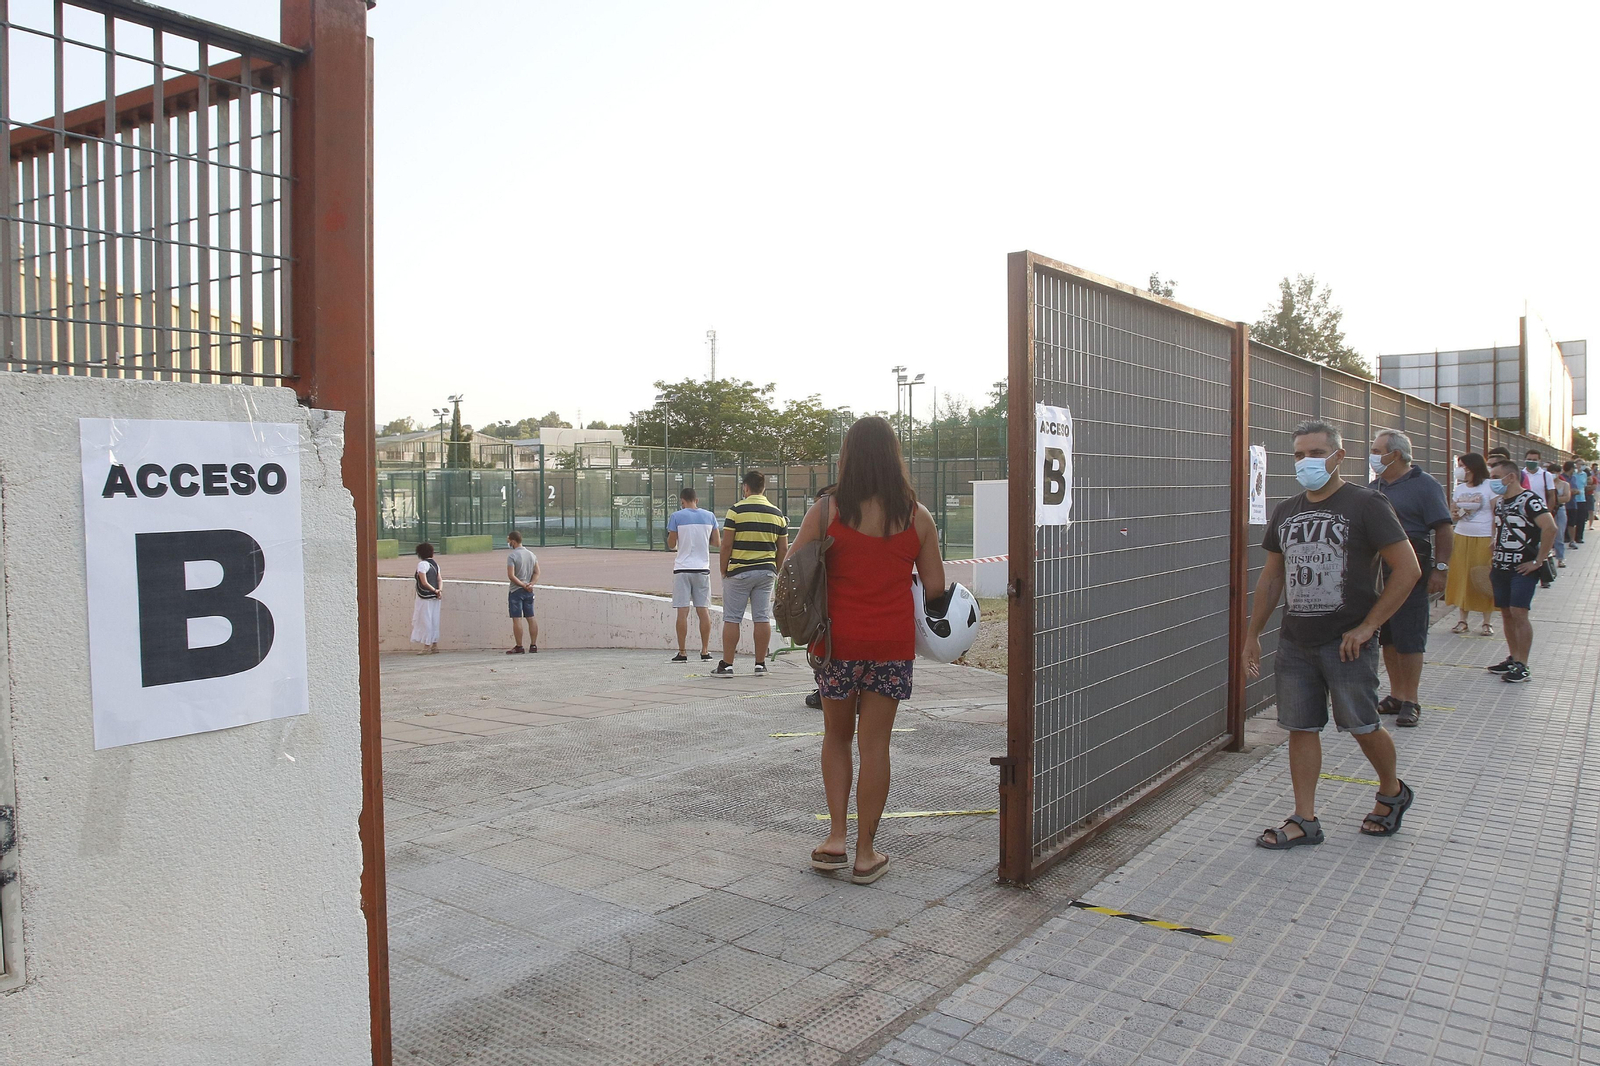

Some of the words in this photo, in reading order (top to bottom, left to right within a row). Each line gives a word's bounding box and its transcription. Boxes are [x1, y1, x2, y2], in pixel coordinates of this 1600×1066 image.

[1040, 421, 1070, 437] ACCESO
[102, 463, 288, 498] ACCESO
[1043, 447, 1066, 505] B
[501, 486, 506, 499] 1
[548, 486, 556, 499] 2
[1290, 566, 1322, 587] 501
[135, 529, 275, 688] B
